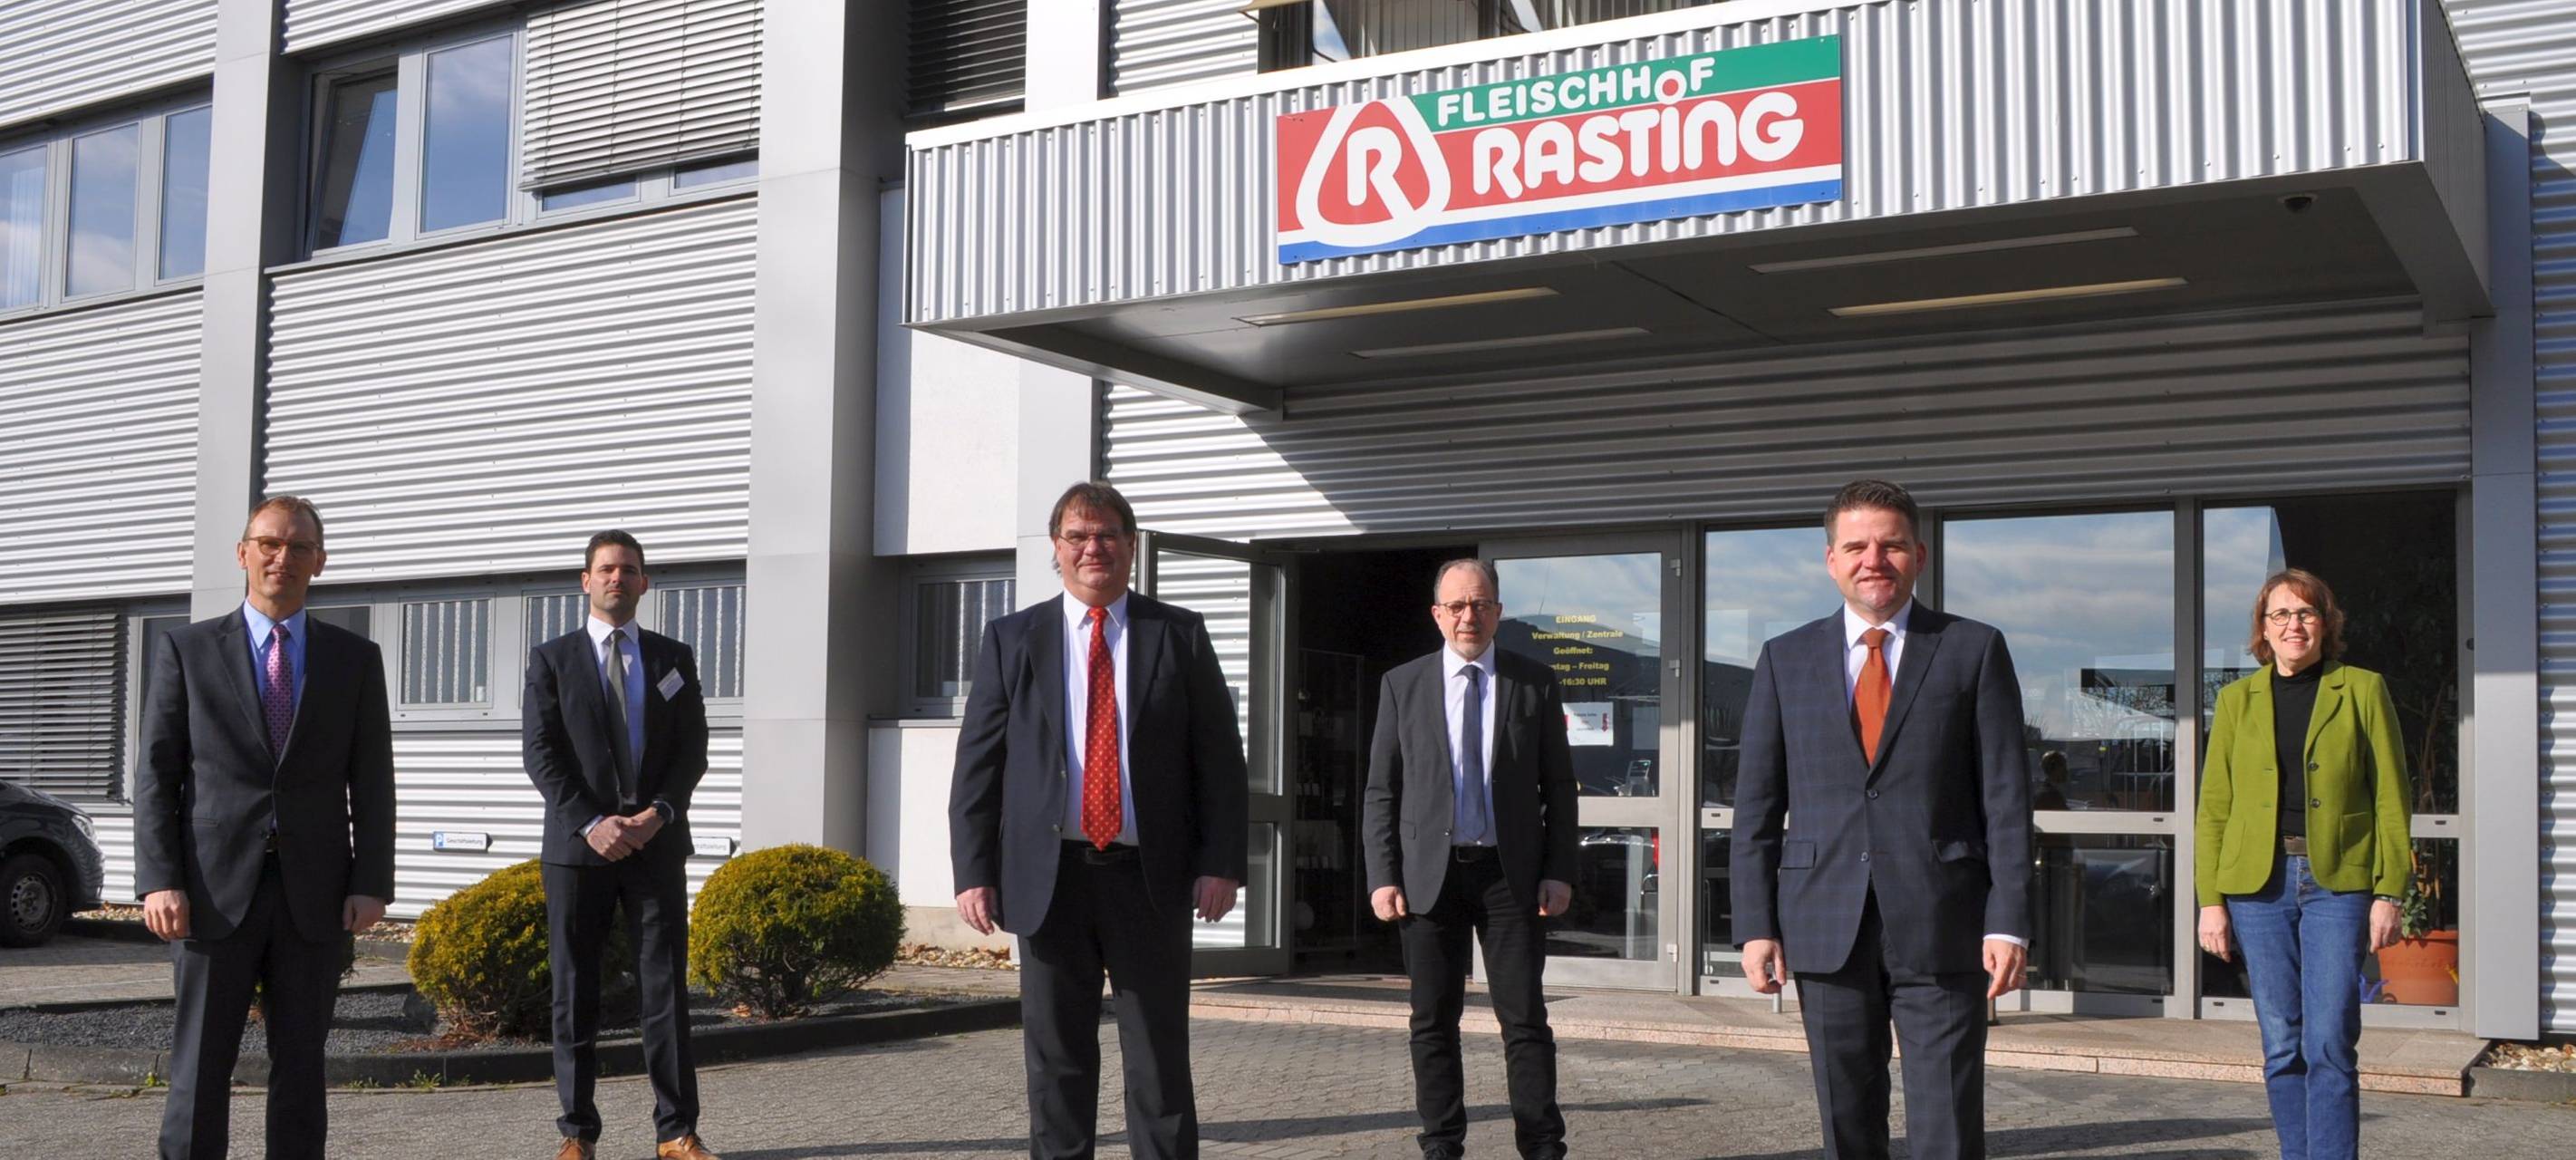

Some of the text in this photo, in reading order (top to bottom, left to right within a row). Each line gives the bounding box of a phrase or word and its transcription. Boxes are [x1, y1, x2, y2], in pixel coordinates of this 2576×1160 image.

[1438, 57, 1714, 126] FLEISCHHOF
[1346, 126, 1413, 216] R
[1556, 615, 1597, 624] EINGANG
[1531, 632, 1580, 640] Verwaltung
[1587, 630, 1624, 638] Zentrale
[1553, 646, 1593, 654] Geöffnet:
[1578, 662, 1609, 671] Freitag
[1587, 677, 1606, 685] UHR
